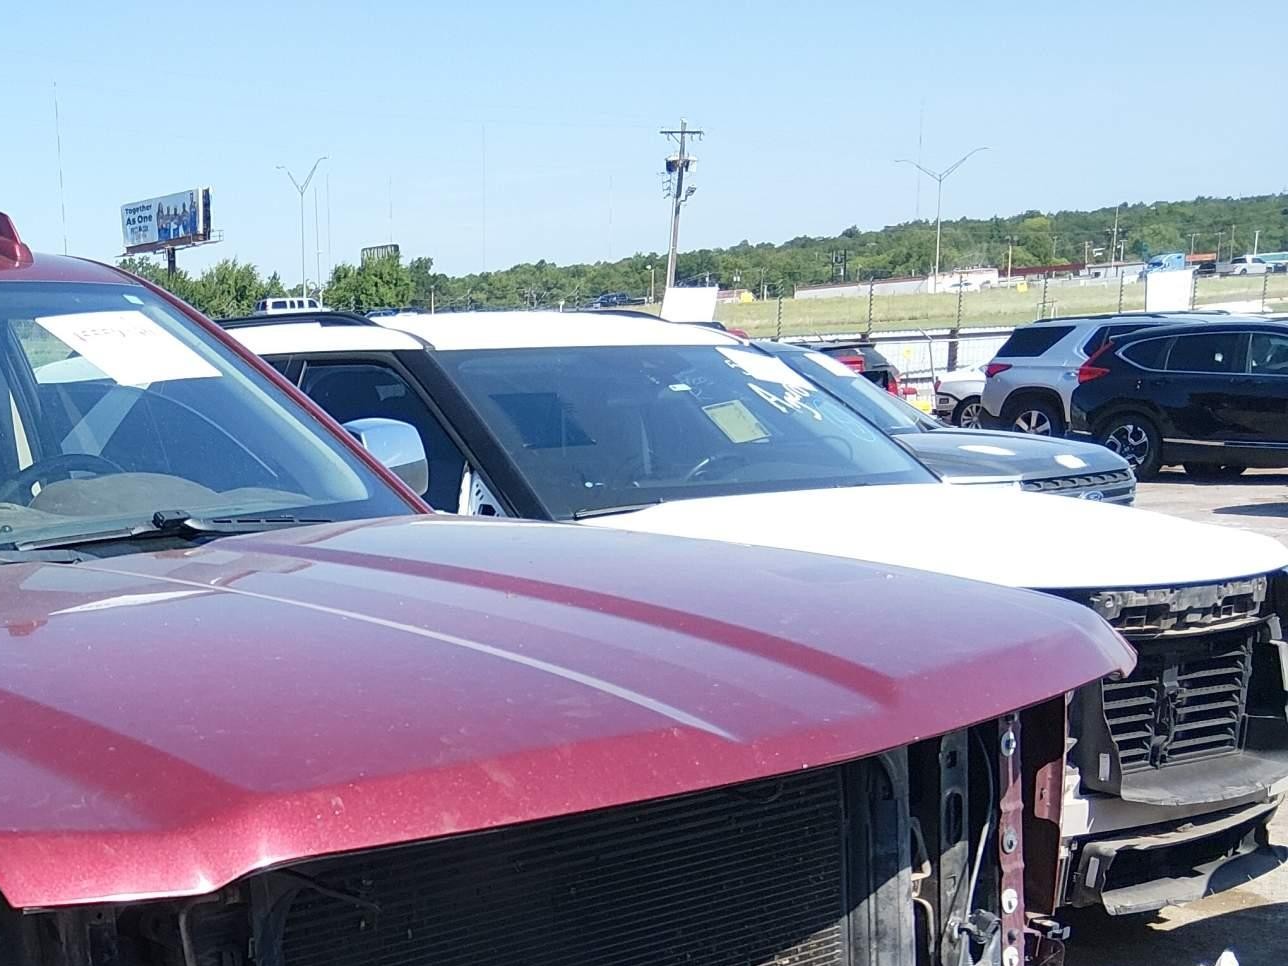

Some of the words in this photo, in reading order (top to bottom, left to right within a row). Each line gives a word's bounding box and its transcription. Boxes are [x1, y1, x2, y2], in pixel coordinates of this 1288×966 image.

[125, 204, 152, 215] Together
[126, 217, 136, 226] As
[137, 214, 152, 224] One
